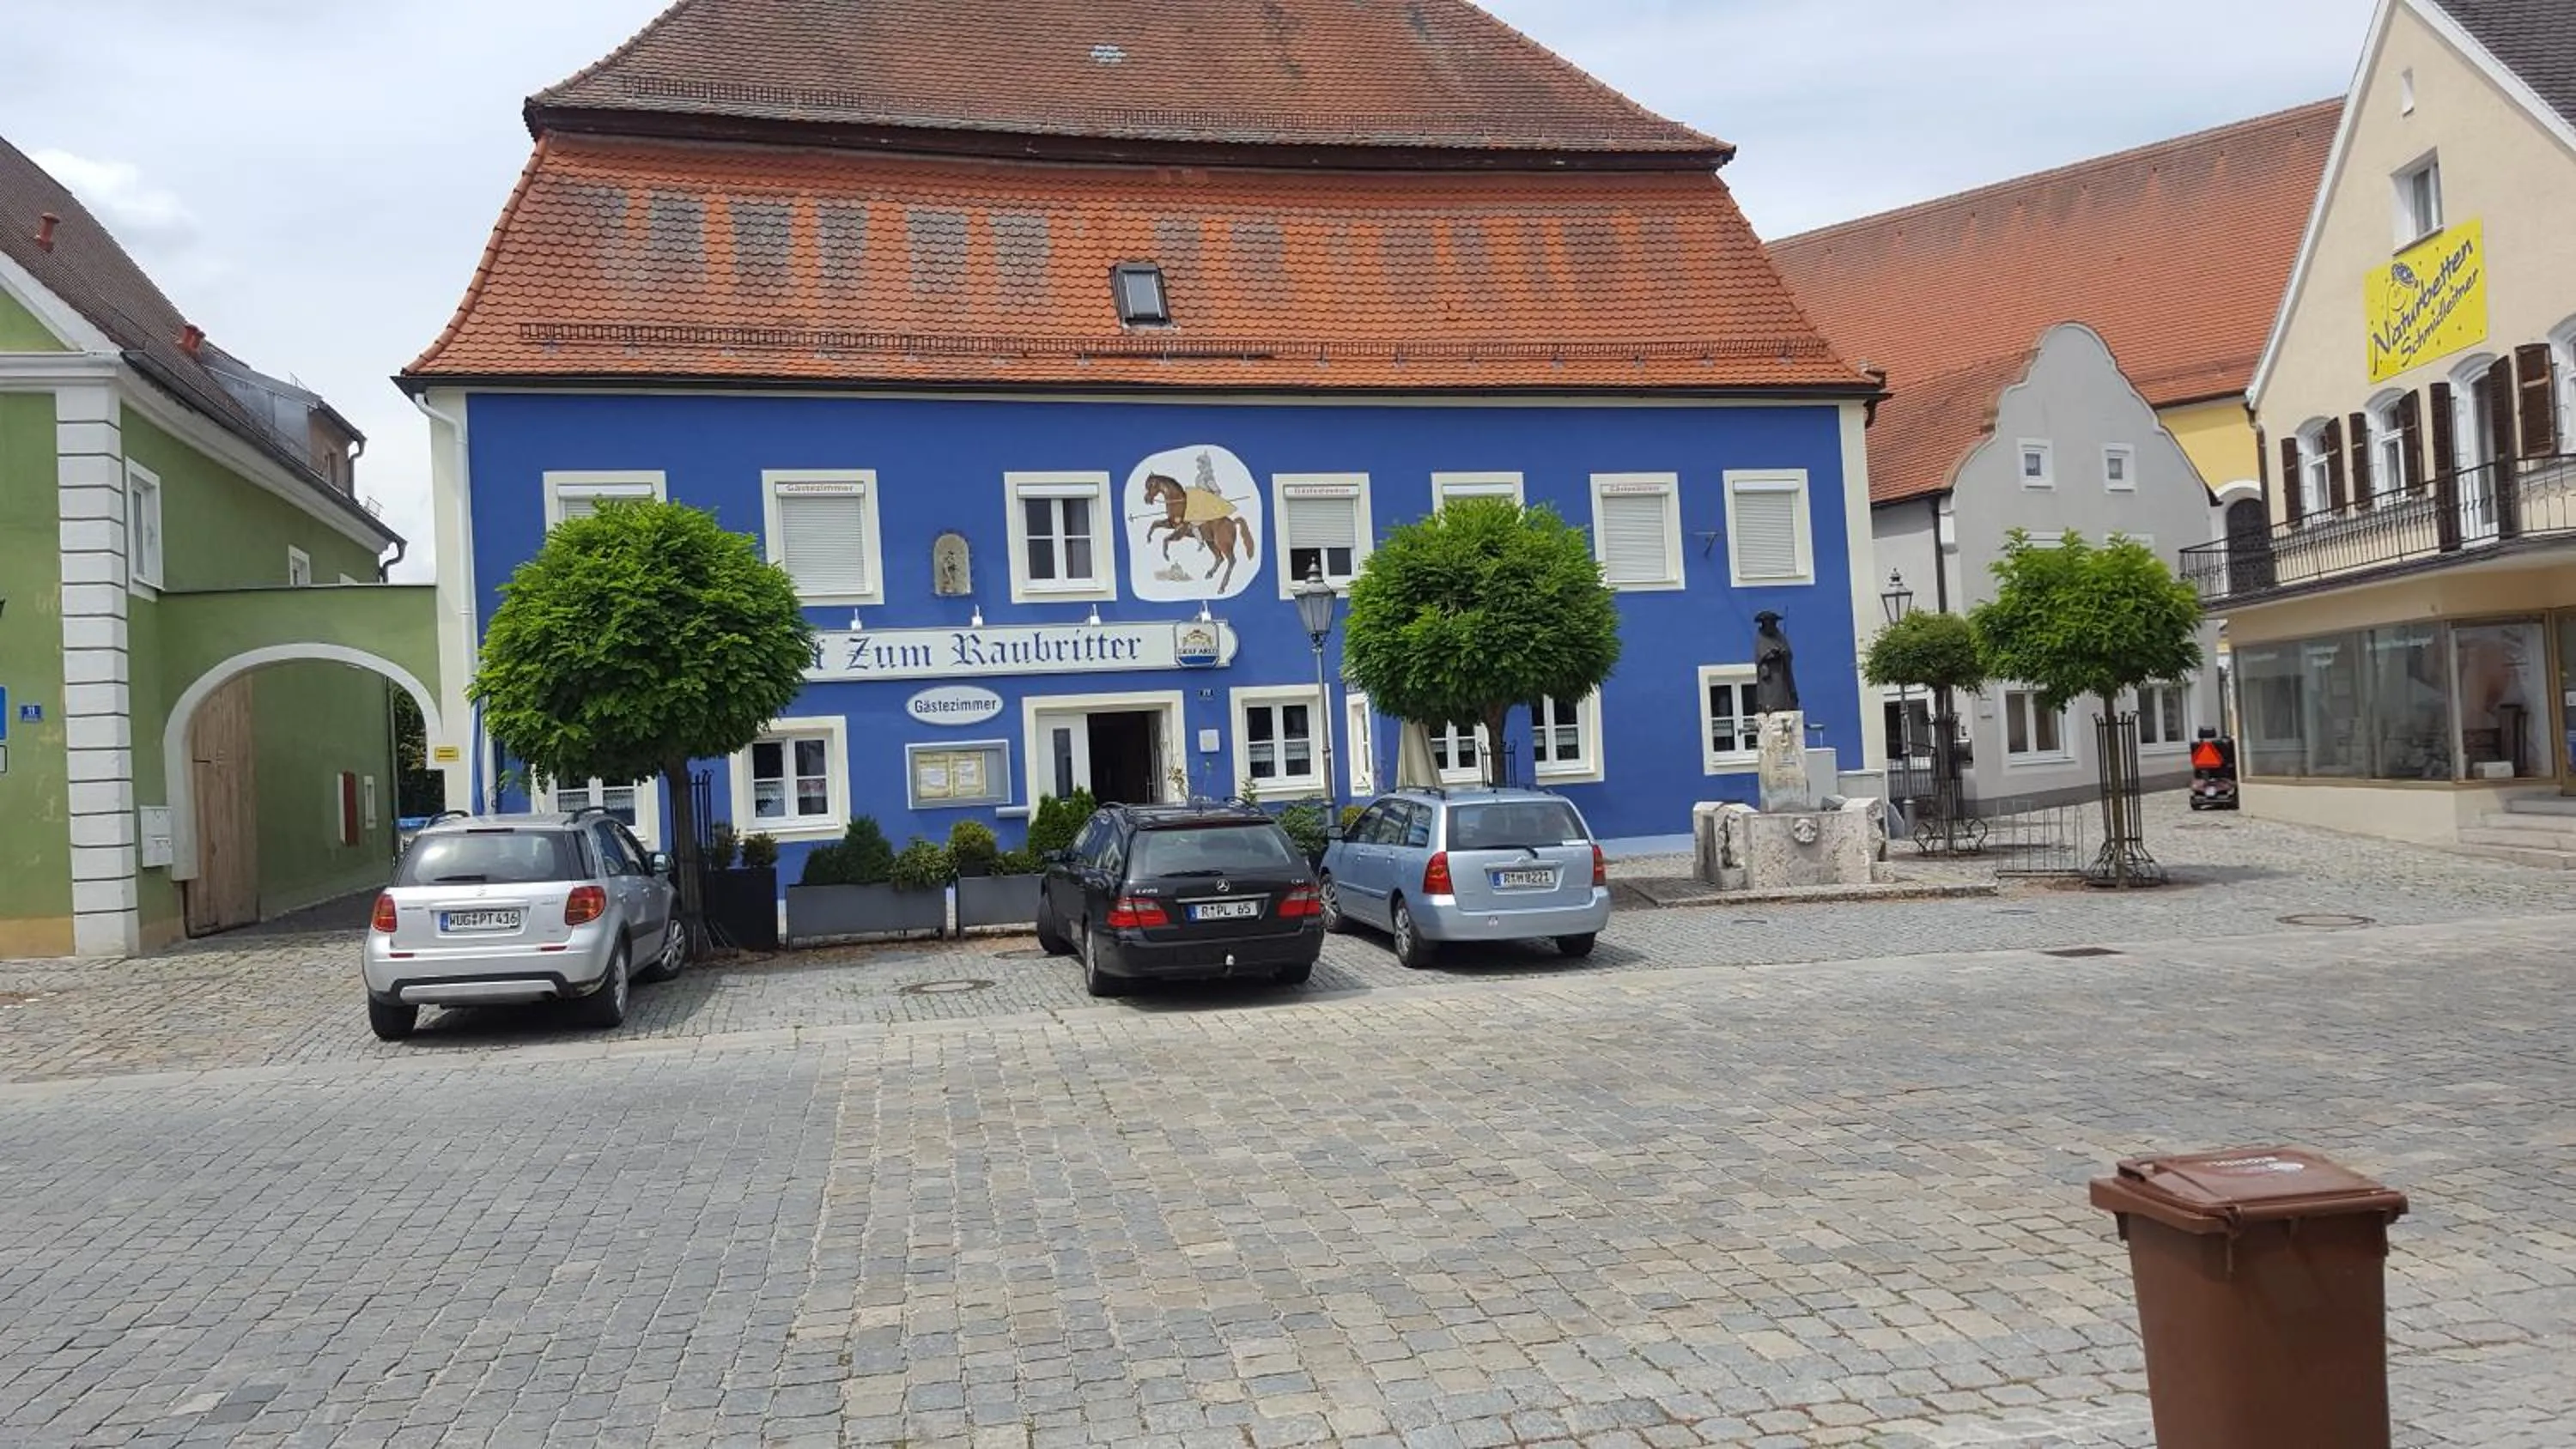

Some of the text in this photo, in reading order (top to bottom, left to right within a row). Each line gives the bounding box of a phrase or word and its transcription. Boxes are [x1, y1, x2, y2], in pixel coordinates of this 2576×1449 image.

[845, 637, 933, 670] Zum
[950, 628, 1142, 666] Raubritter
[914, 697, 997, 713] Gästezimmer
